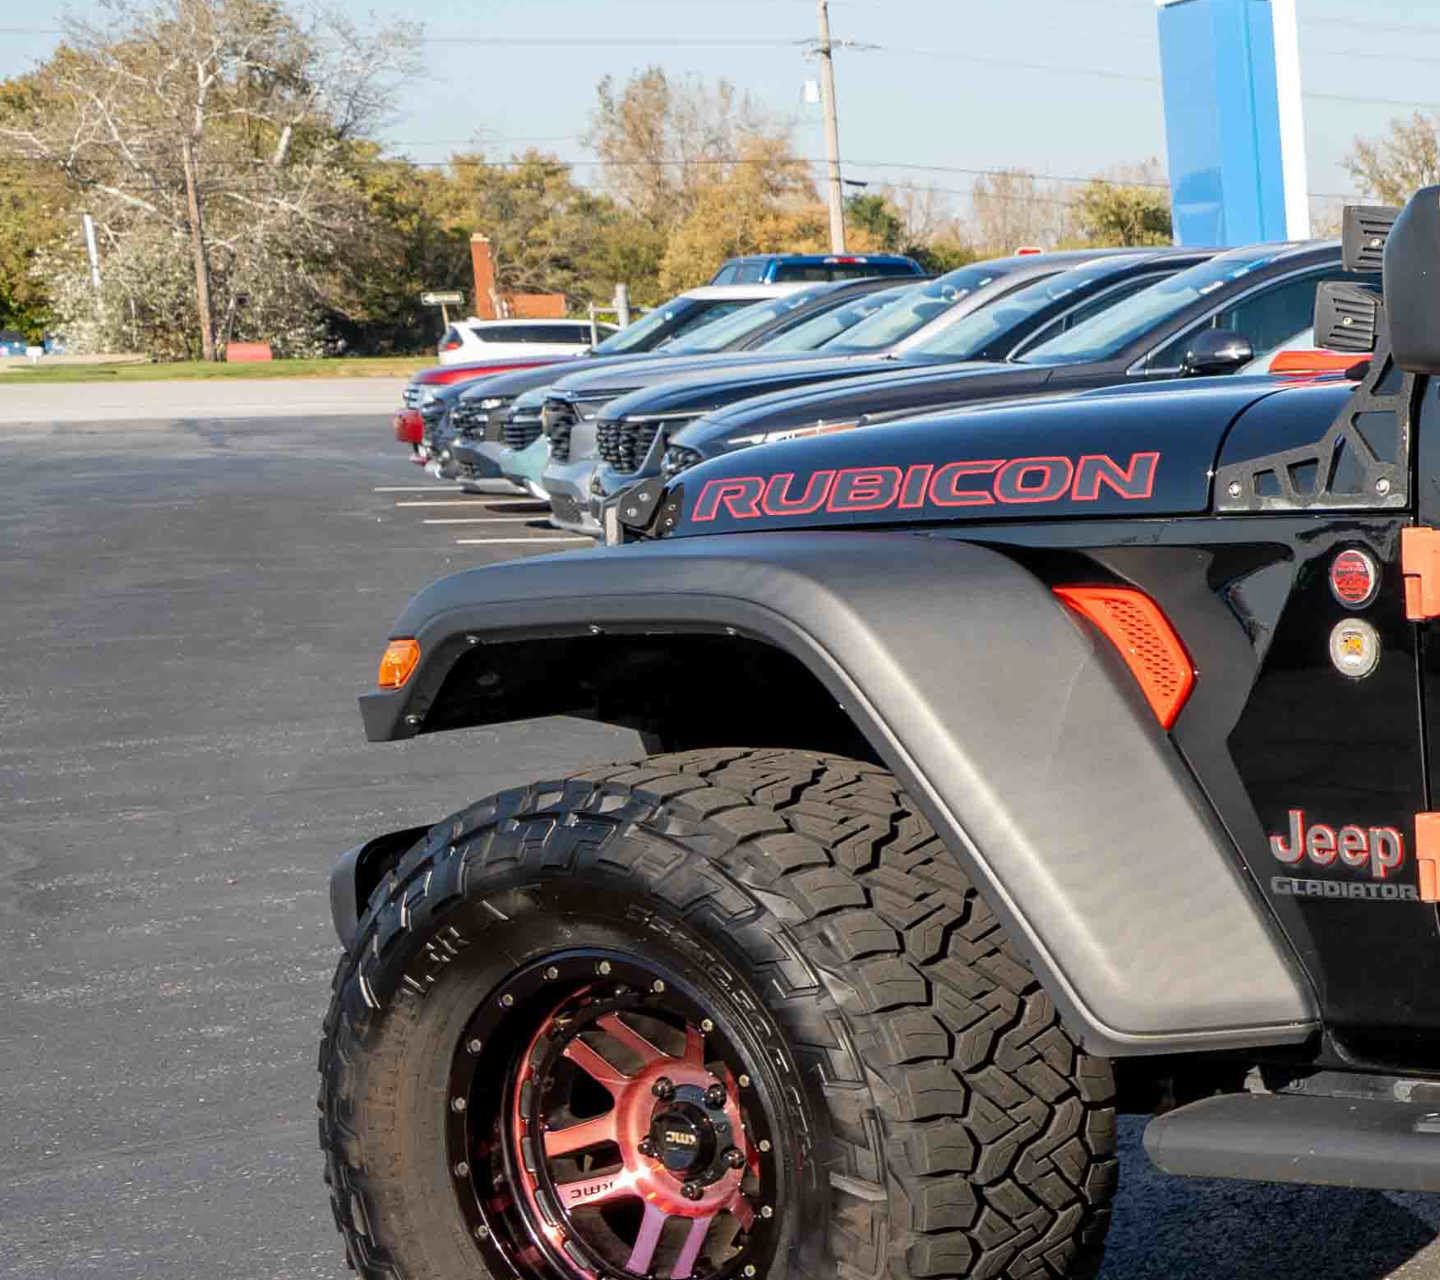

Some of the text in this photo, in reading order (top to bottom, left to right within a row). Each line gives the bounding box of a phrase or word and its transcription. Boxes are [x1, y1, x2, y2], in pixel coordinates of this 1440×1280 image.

[691, 452, 1161, 522] RUBICON
[1269, 809, 1404, 879] Jeep
[1271, 876, 1420, 901] GLADIATOR
